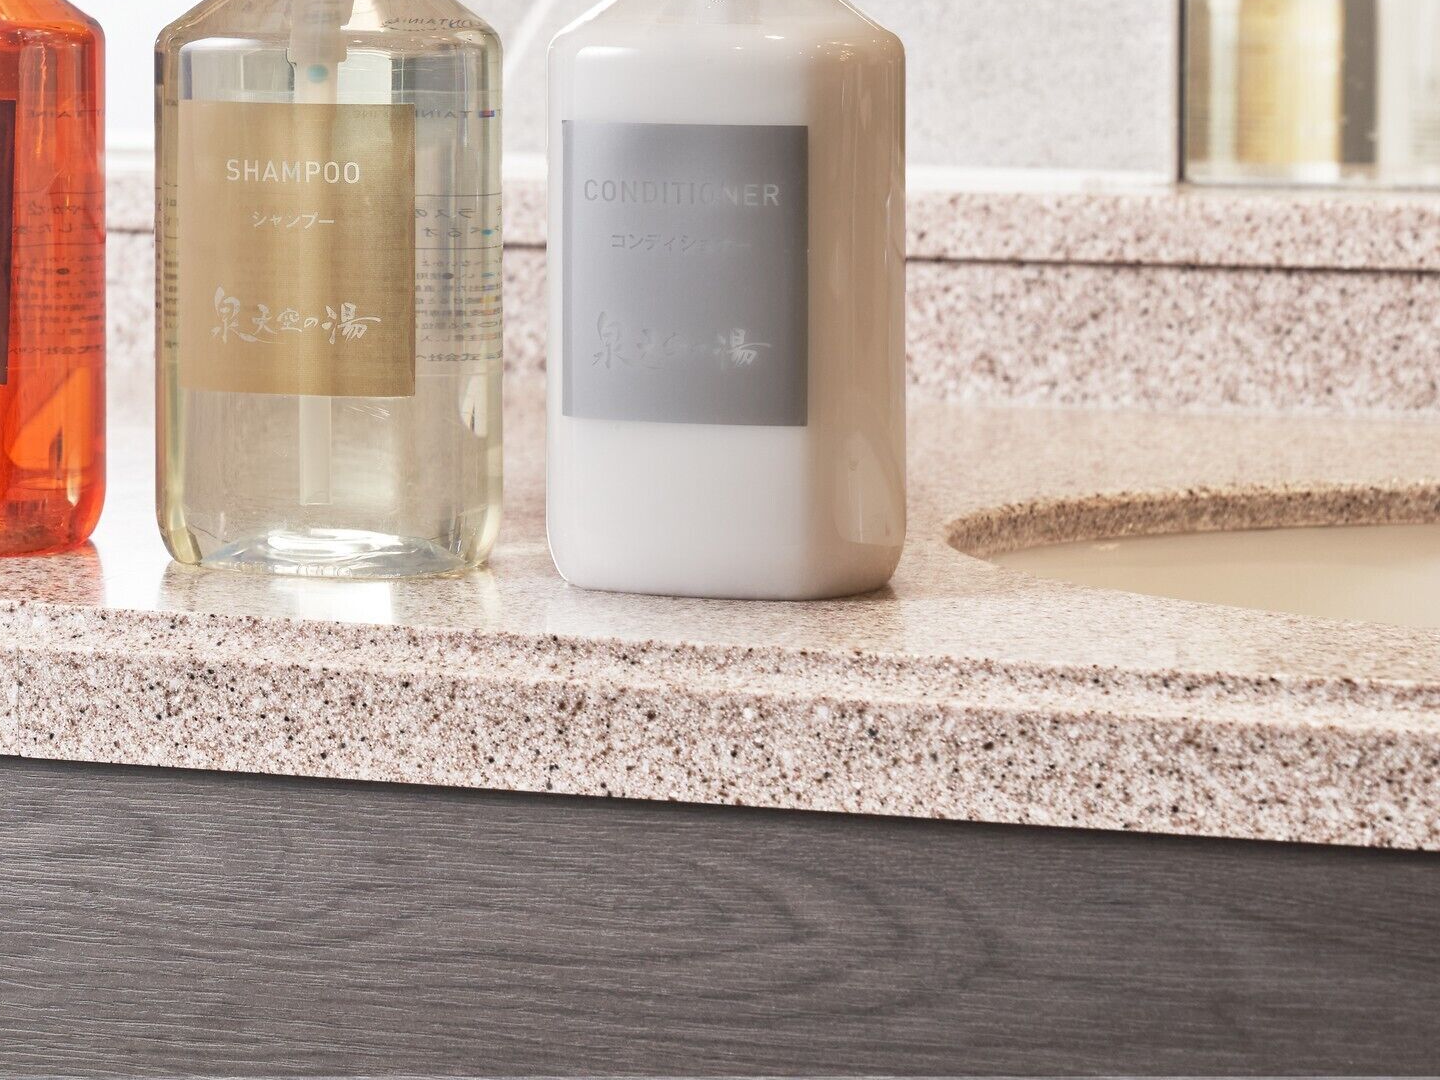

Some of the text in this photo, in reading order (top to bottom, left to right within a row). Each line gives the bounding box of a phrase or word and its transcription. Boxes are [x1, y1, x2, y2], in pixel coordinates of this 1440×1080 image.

[226, 158, 361, 185] SHAMPOO
[583, 178, 782, 207] CONDITIONER
[251, 210, 336, 231] シャンプー
